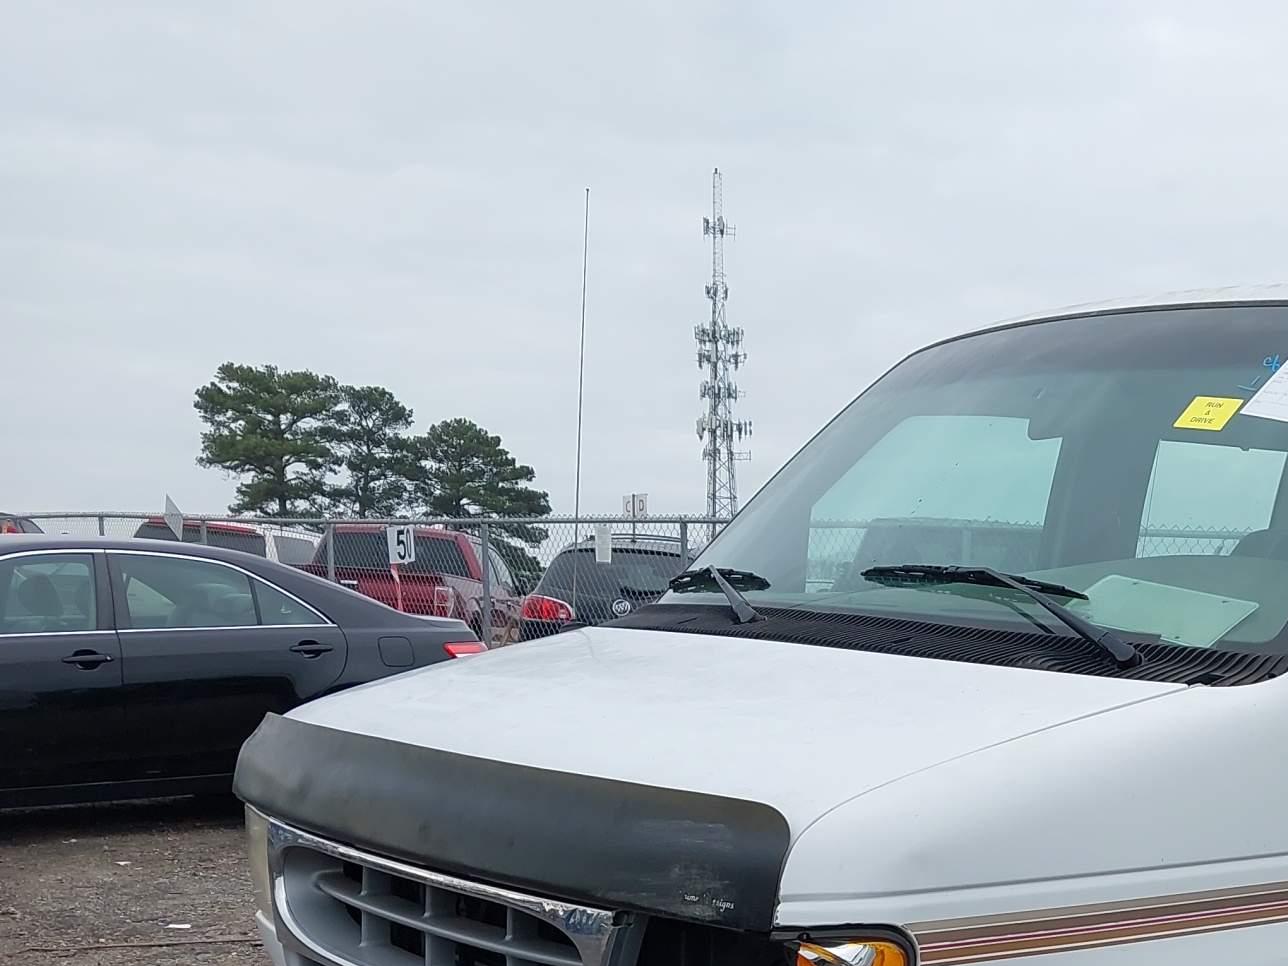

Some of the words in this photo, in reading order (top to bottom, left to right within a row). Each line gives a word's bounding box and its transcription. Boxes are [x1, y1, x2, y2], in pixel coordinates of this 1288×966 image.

[1205, 401, 1225, 409] RUN
[1190, 416, 1216, 425] DRIVE
[638, 499, 645, 512] D
[396, 527, 412, 561] 50
